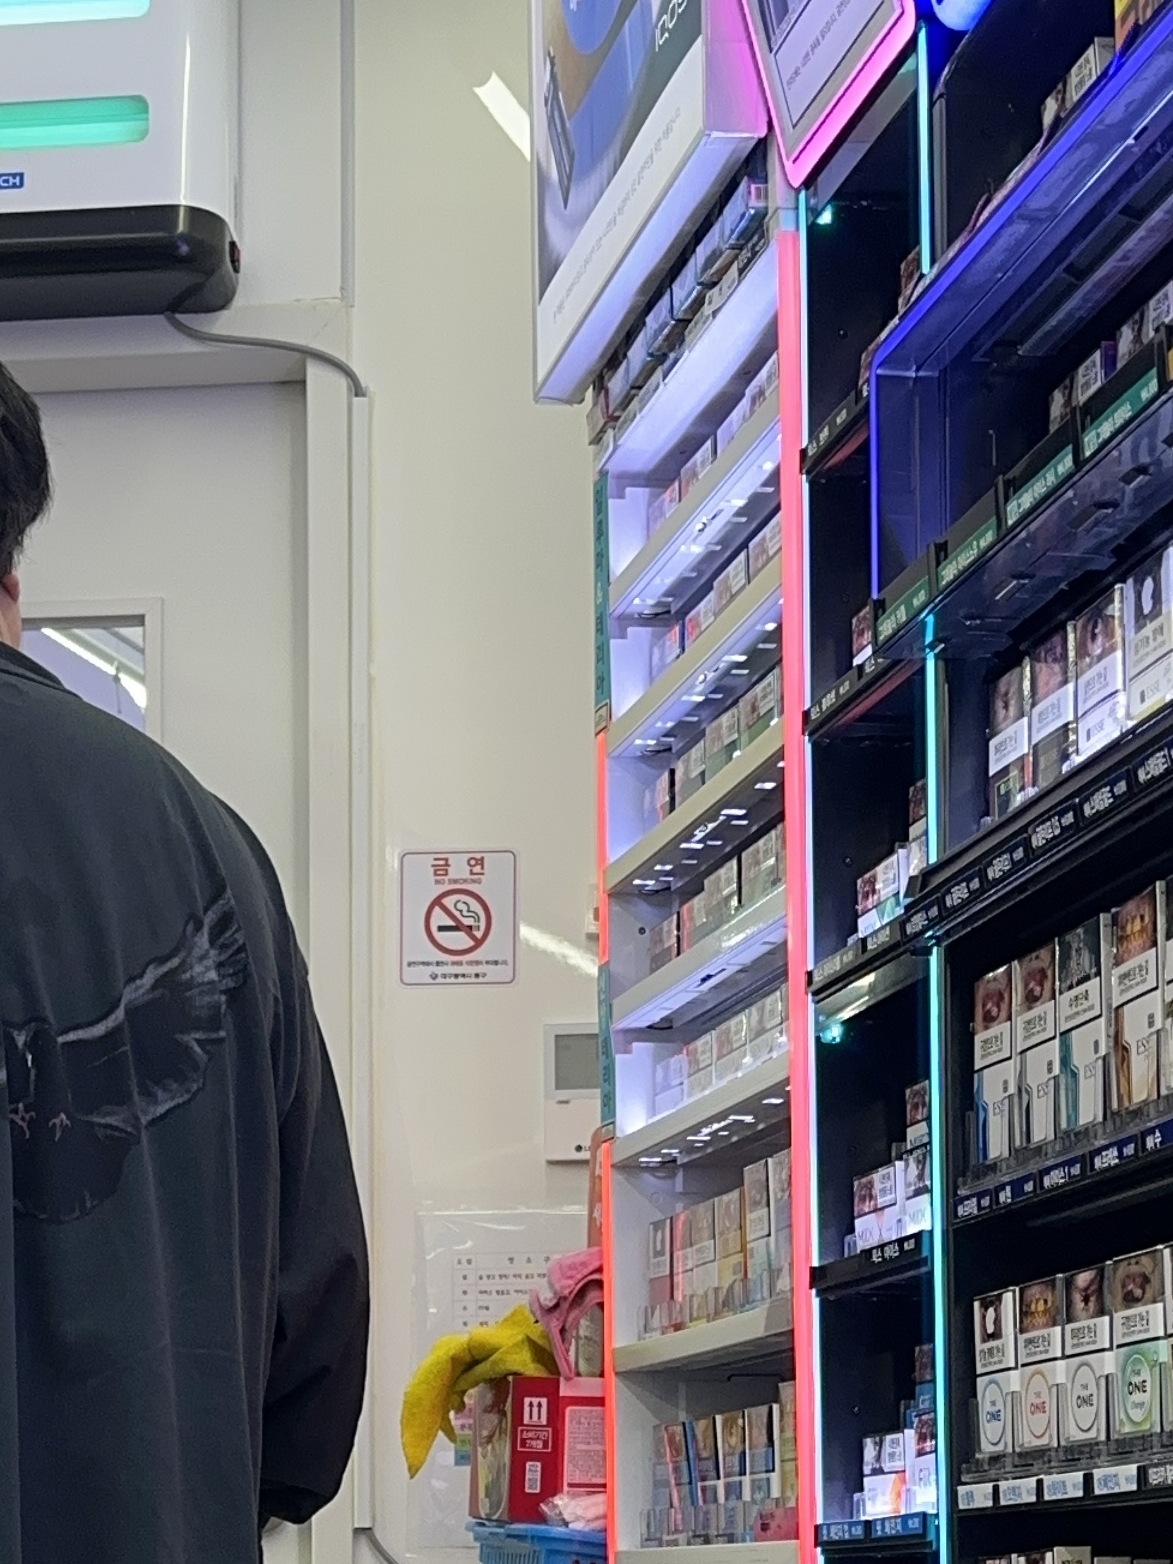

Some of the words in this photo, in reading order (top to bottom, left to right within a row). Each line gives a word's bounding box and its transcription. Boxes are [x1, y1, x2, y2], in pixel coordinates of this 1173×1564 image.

[431, 857, 451, 876] 금
[467, 856, 485, 876] 연
[1128, 1380, 1148, 1396] ONE
[1029, 1401, 1047, 1416] ONE
[1076, 1394, 1094, 1409] ONE
[985, 1409, 1002, 1424] ONE
